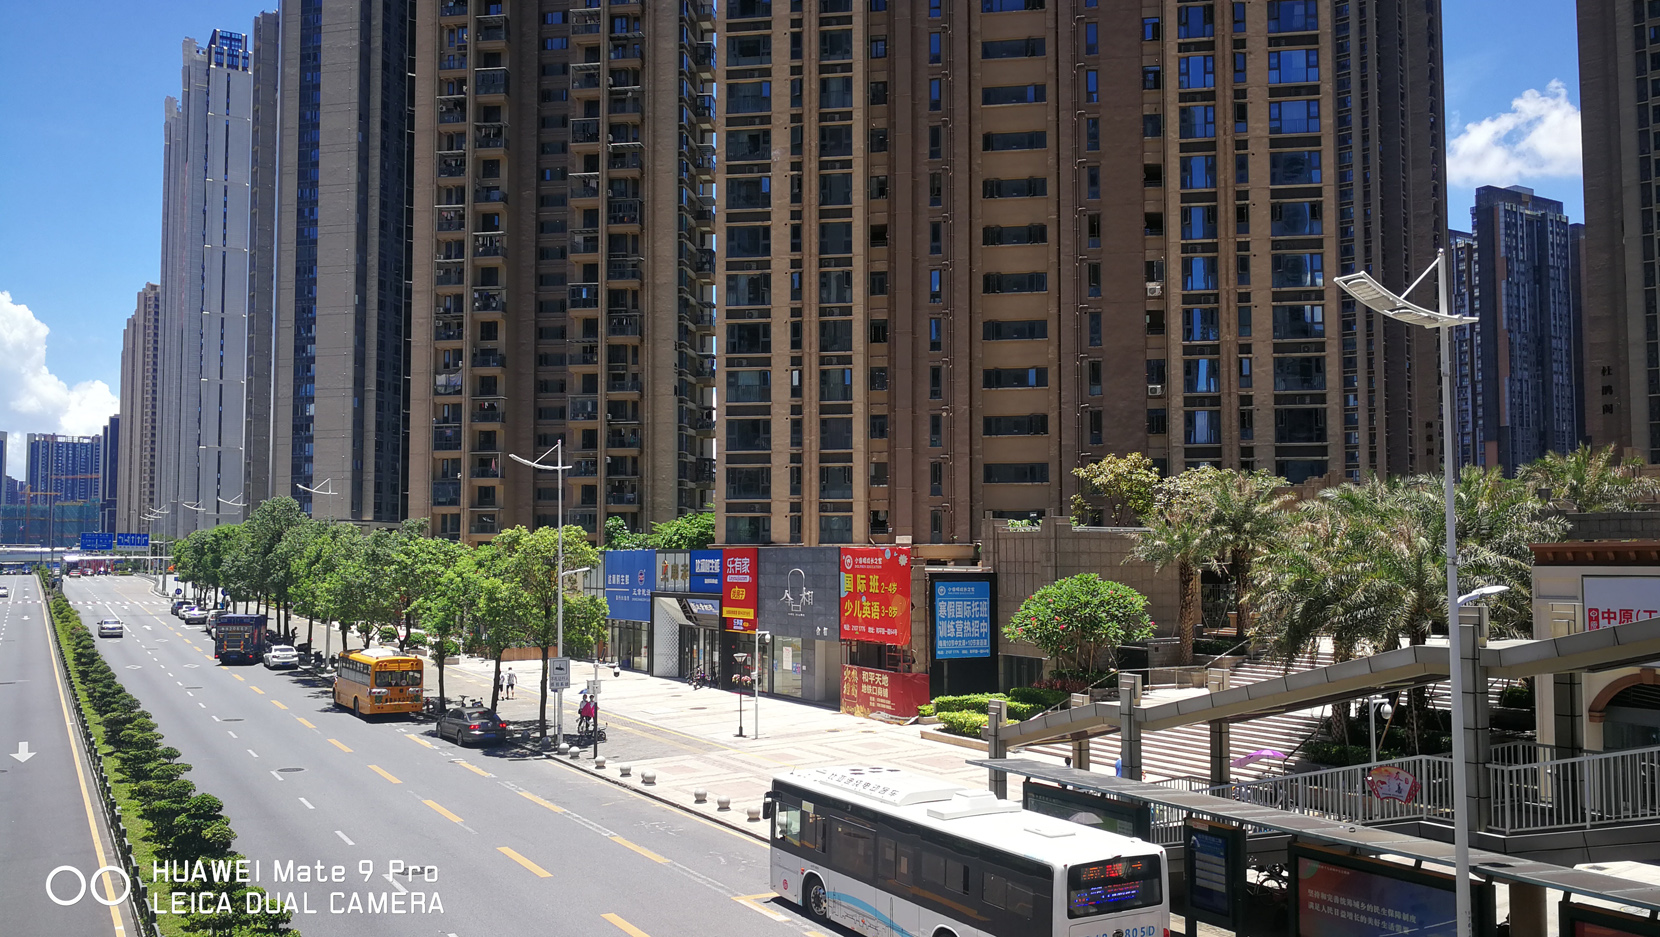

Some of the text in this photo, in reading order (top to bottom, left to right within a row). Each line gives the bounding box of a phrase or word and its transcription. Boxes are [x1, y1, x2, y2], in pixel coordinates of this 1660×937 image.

[726, 557, 750, 574] 乐有家
[844, 573, 898, 595] 国际班 2-4岁
[844, 599, 898, 619] 少儿英语 3-8岁
[938, 600, 988, 618] 寒假国际托班
[938, 620, 988, 638] 训练营热招中
[862, 671, 889, 686] 和平天地
[861, 684, 889, 698] 地铁口商铺
[1308, 889, 1417, 924] 坚持和完善统筹城乡的民生保障制度
[1125, 925, 1156, 937] 805D
